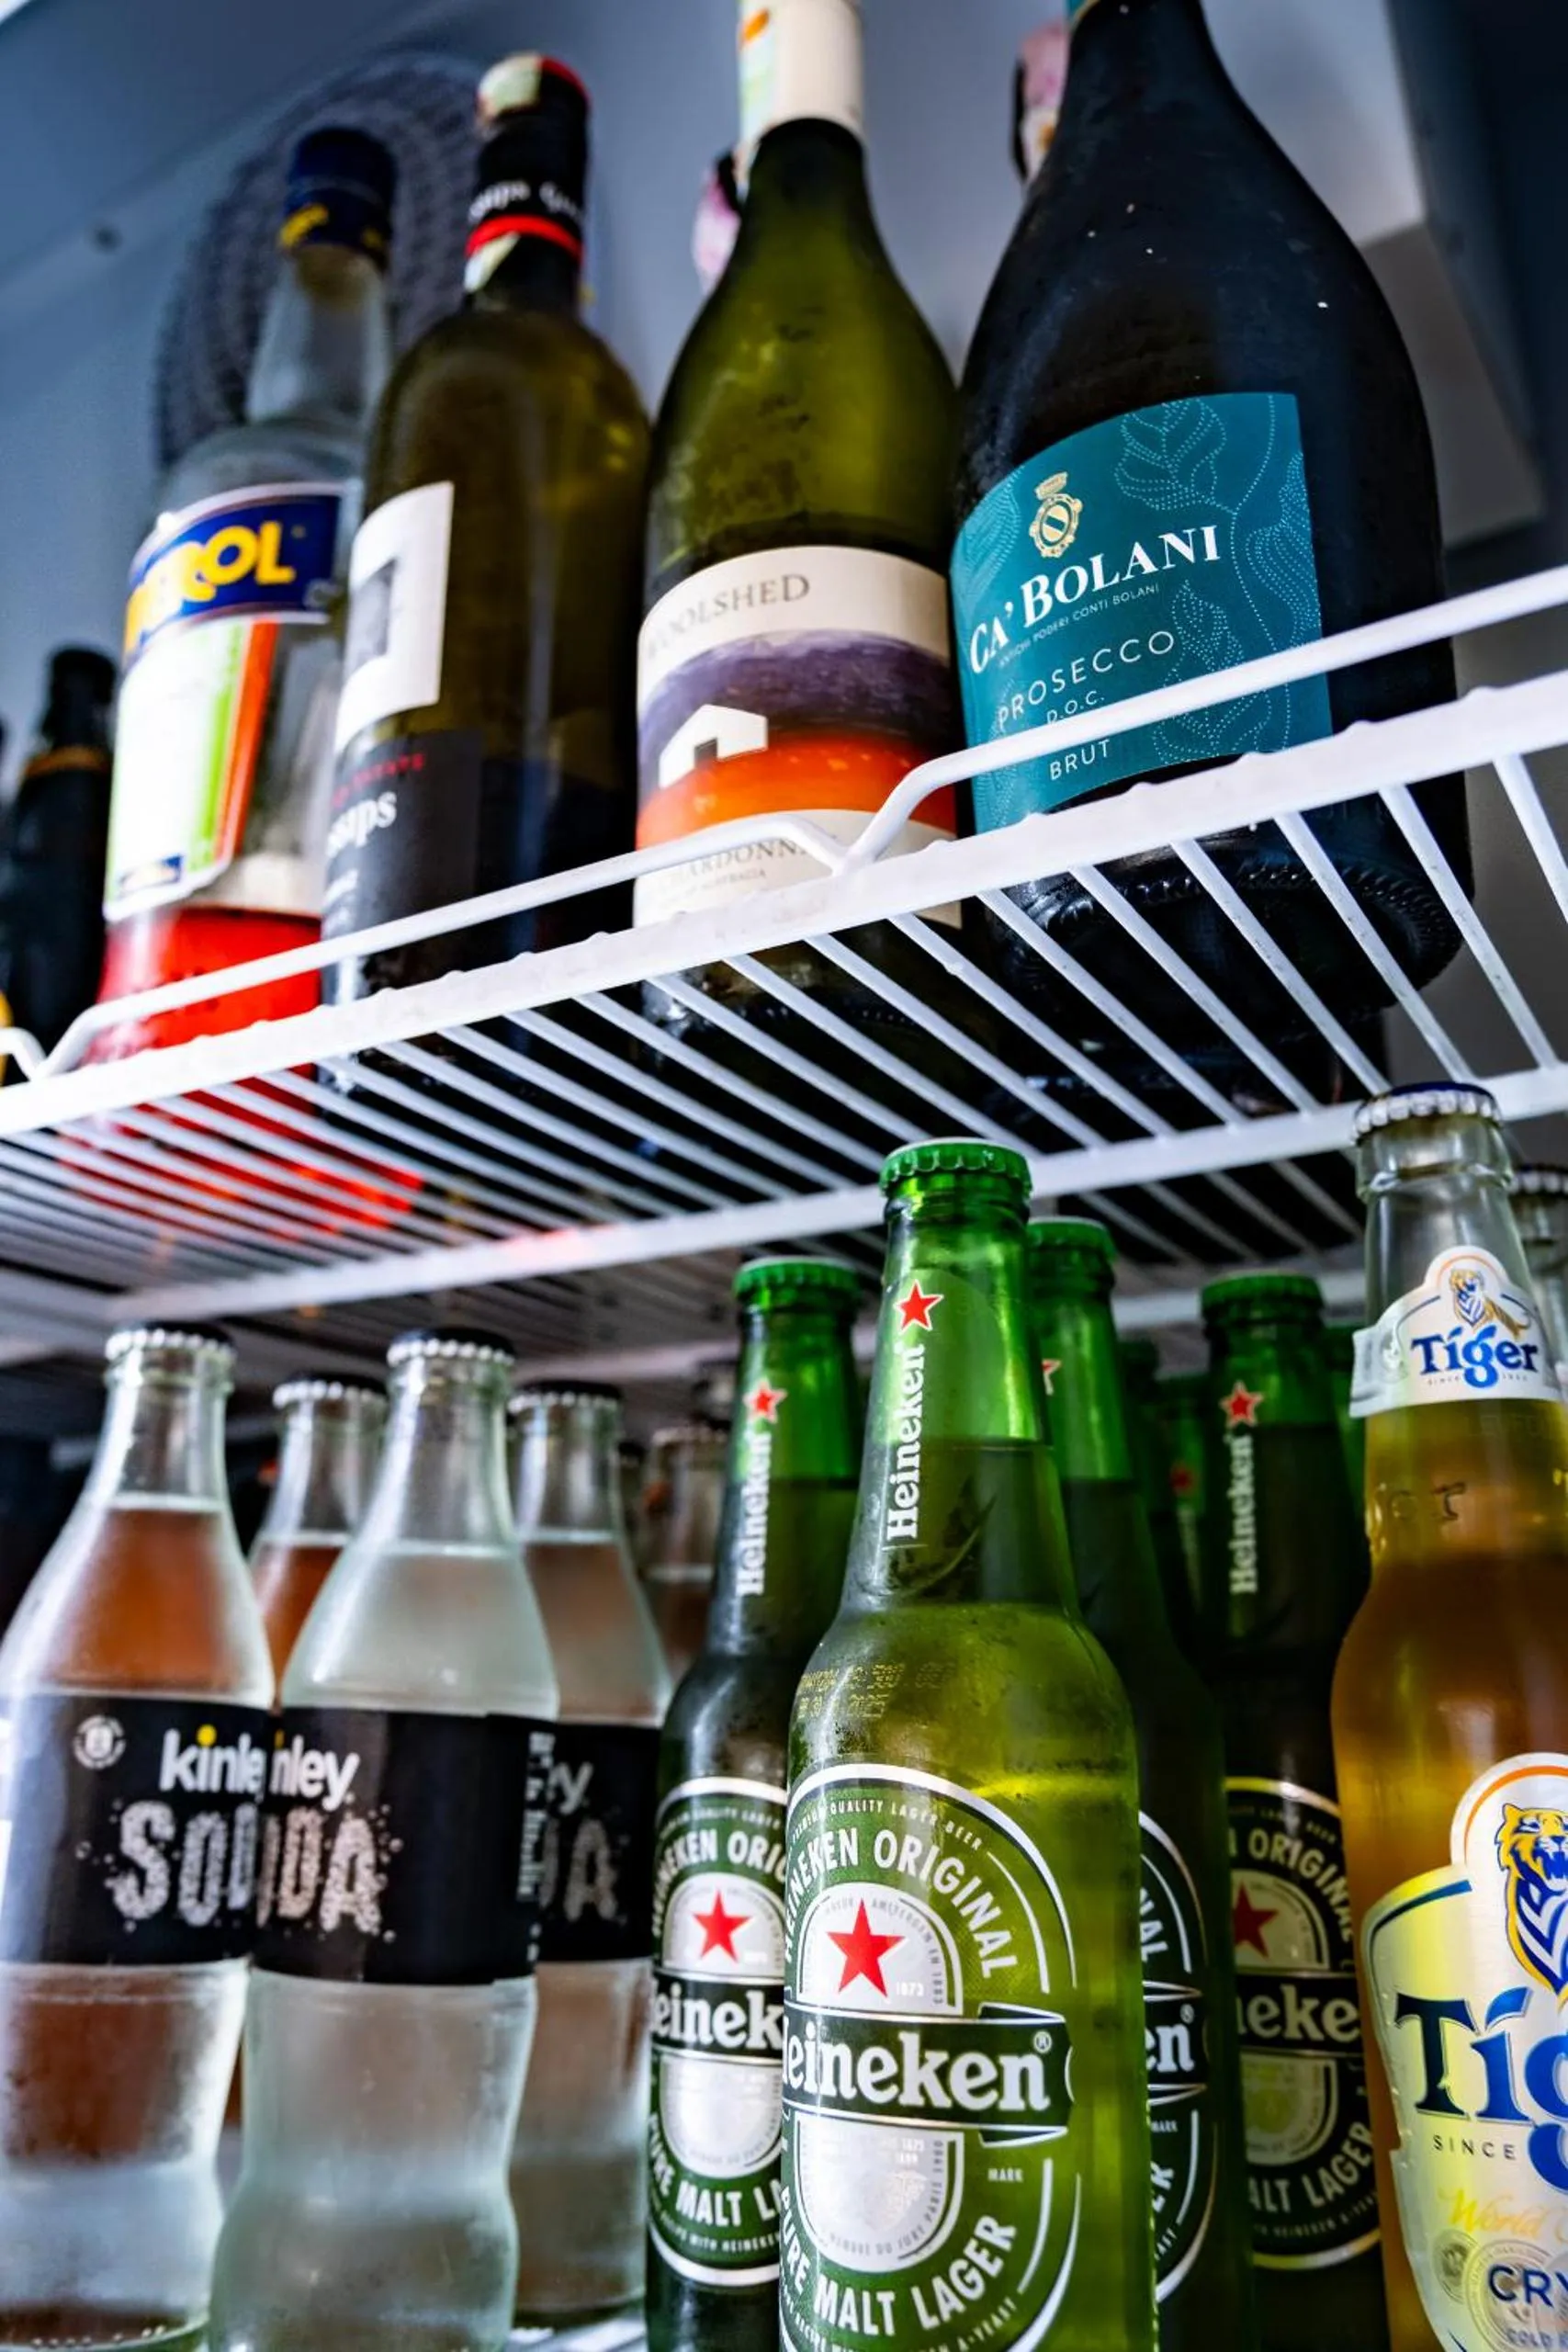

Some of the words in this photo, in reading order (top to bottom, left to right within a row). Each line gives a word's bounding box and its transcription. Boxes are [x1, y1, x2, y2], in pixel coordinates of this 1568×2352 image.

[123, 521, 295, 654] ROL
[1072, 600, 1110, 621] CONTI
[1112, 582, 1159, 605] BOLANI
[998, 631, 1174, 733] PROSECCO
[1050, 739, 1110, 780] BRUT
[1410, 1324, 1539, 1389] Tiger
[886, 1341, 925, 1541] Heineken
[736, 1426, 772, 1595] Heineken
[1224, 1433, 1258, 1594] Heineken
[160, 1724, 267, 1804] kinle
[269, 1729, 361, 1812] nley
[829, 1799, 884, 1816] QUALITY
[891, 1802, 939, 1827] LAGER
[944, 1819, 982, 1851] BEER
[874, 1828, 1019, 1979] ORIGINAL
[987, 2168, 1023, 2183] MARK
[1433, 2133, 1518, 2160] SINCE
[676, 2179, 742, 2228] MALT
[814, 2273, 897, 2336] MALT
[910, 2215, 1017, 2331] LAGER
[1488, 2264, 1568, 2308] CR
